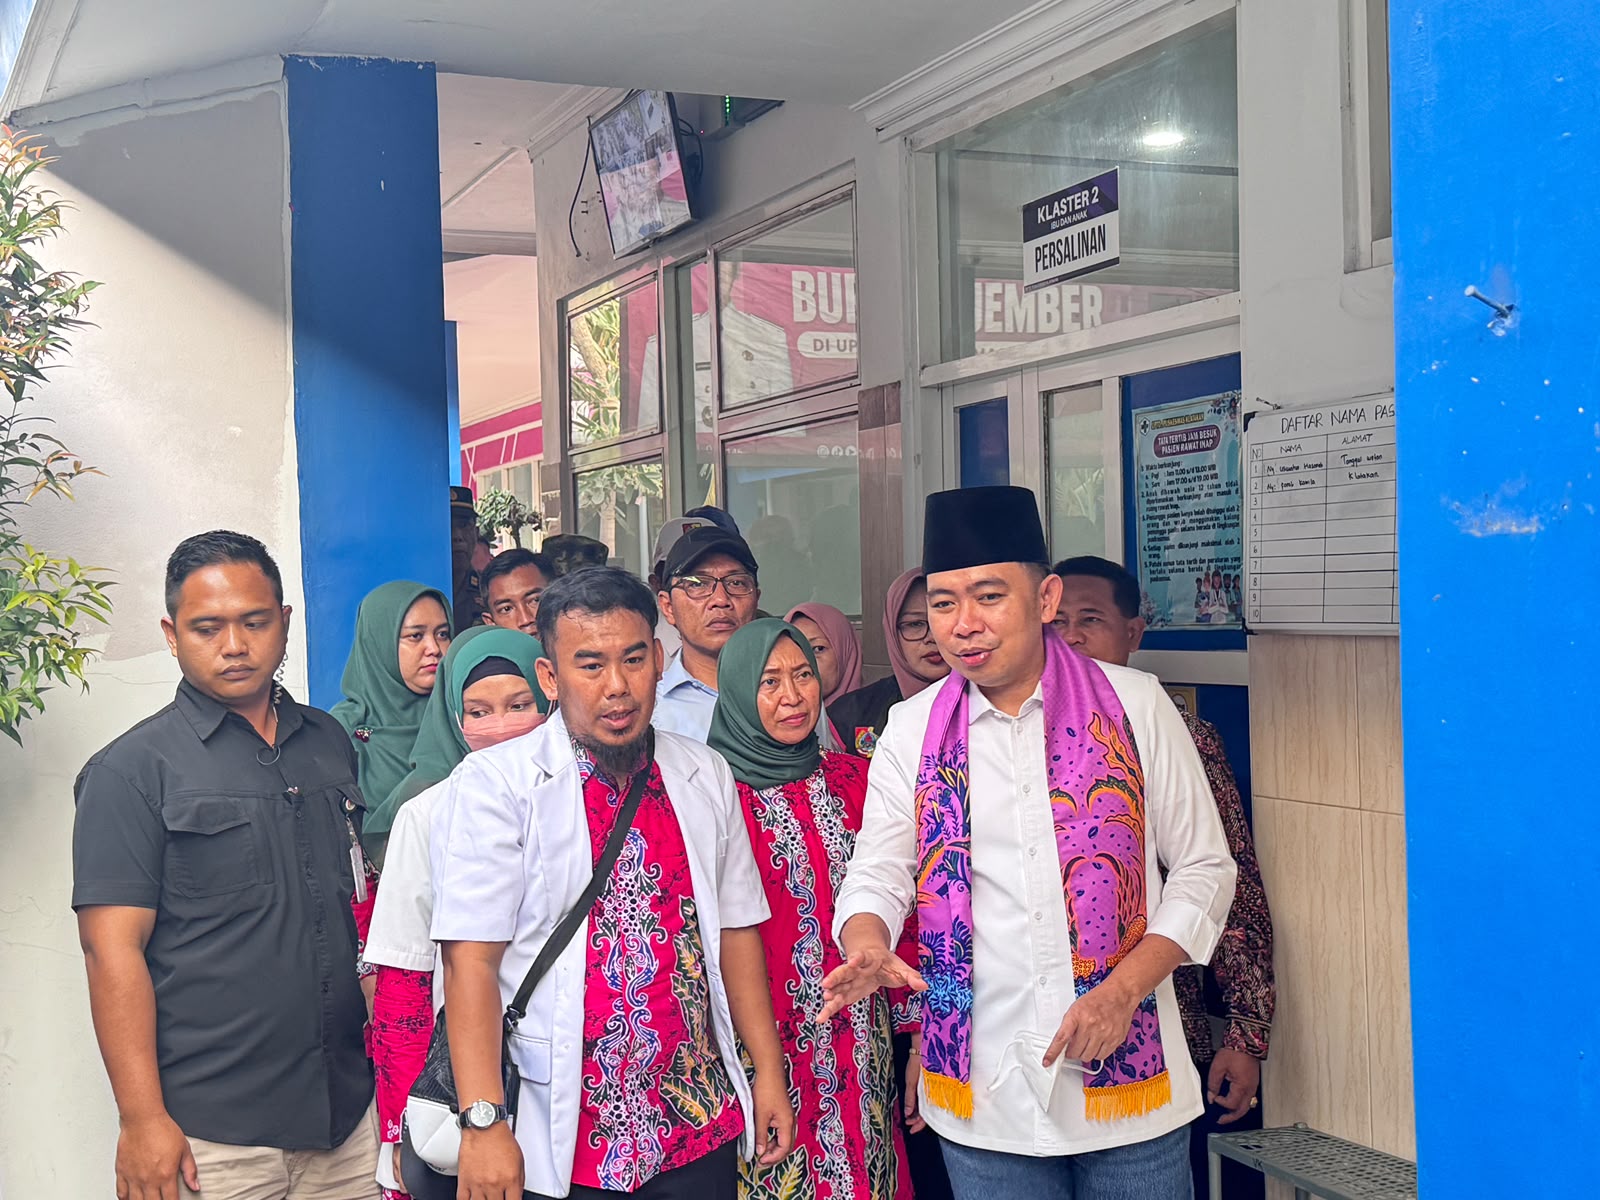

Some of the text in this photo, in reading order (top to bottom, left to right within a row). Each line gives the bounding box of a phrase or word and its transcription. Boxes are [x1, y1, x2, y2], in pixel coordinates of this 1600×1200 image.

[1038, 186, 1099, 224] KLASTER 2
[1051, 210, 1088, 230] IBU DAN ANAK
[1035, 224, 1106, 273] PERSALINAN
[975, 282, 1102, 333] JEMBER
[813, 338, 830, 352] DI
[1281, 404, 1395, 434] DAFTAR NAMA PAS
[1158, 429, 1217, 445] TATA TERTIB JAM BESUK
[1342, 434, 1373, 444] ALAMAT
[1162, 440, 1213, 455] PASIEN RAWAT INAP
[1280, 444, 1302, 454] NAMA
[1253, 561, 1257, 569] 7
[1253, 578, 1257, 586] 8
[1253, 593, 1257, 601] 9
